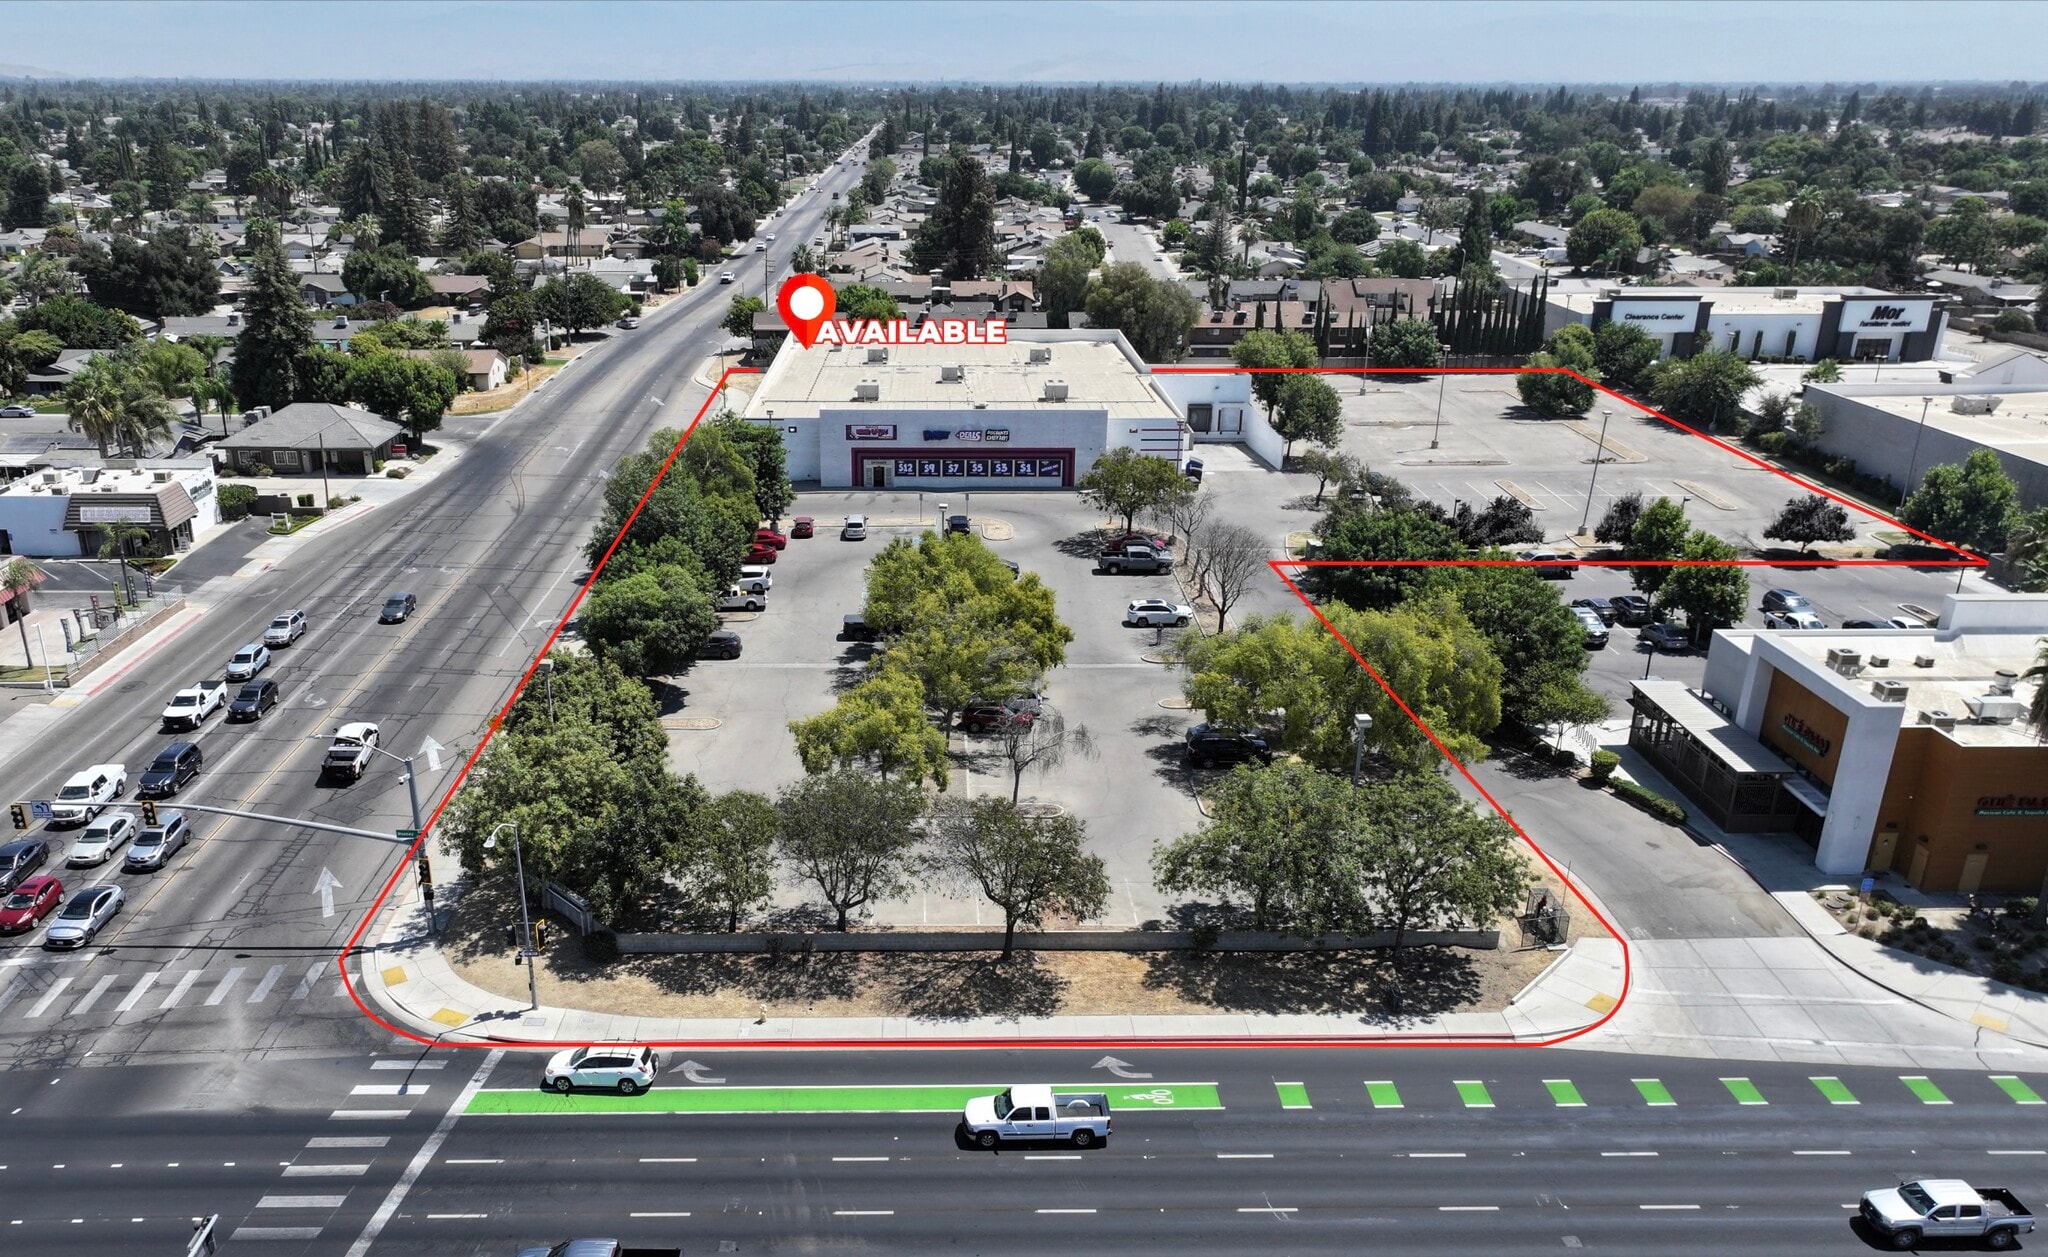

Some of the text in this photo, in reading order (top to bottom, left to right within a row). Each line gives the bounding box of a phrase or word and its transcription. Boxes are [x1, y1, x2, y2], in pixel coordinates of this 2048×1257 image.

[1661, 313, 1685, 321] Center
[1870, 306, 1906, 320] Mor
[1859, 320, 1889, 328] furniture
[898, 463, 913, 472] $12
[924, 463, 935, 473] $9
[948, 463, 959, 473] $7
[972, 463, 983, 473] $5
[995, 463, 1008, 473] $3
[1020, 463, 1032, 473] $1
